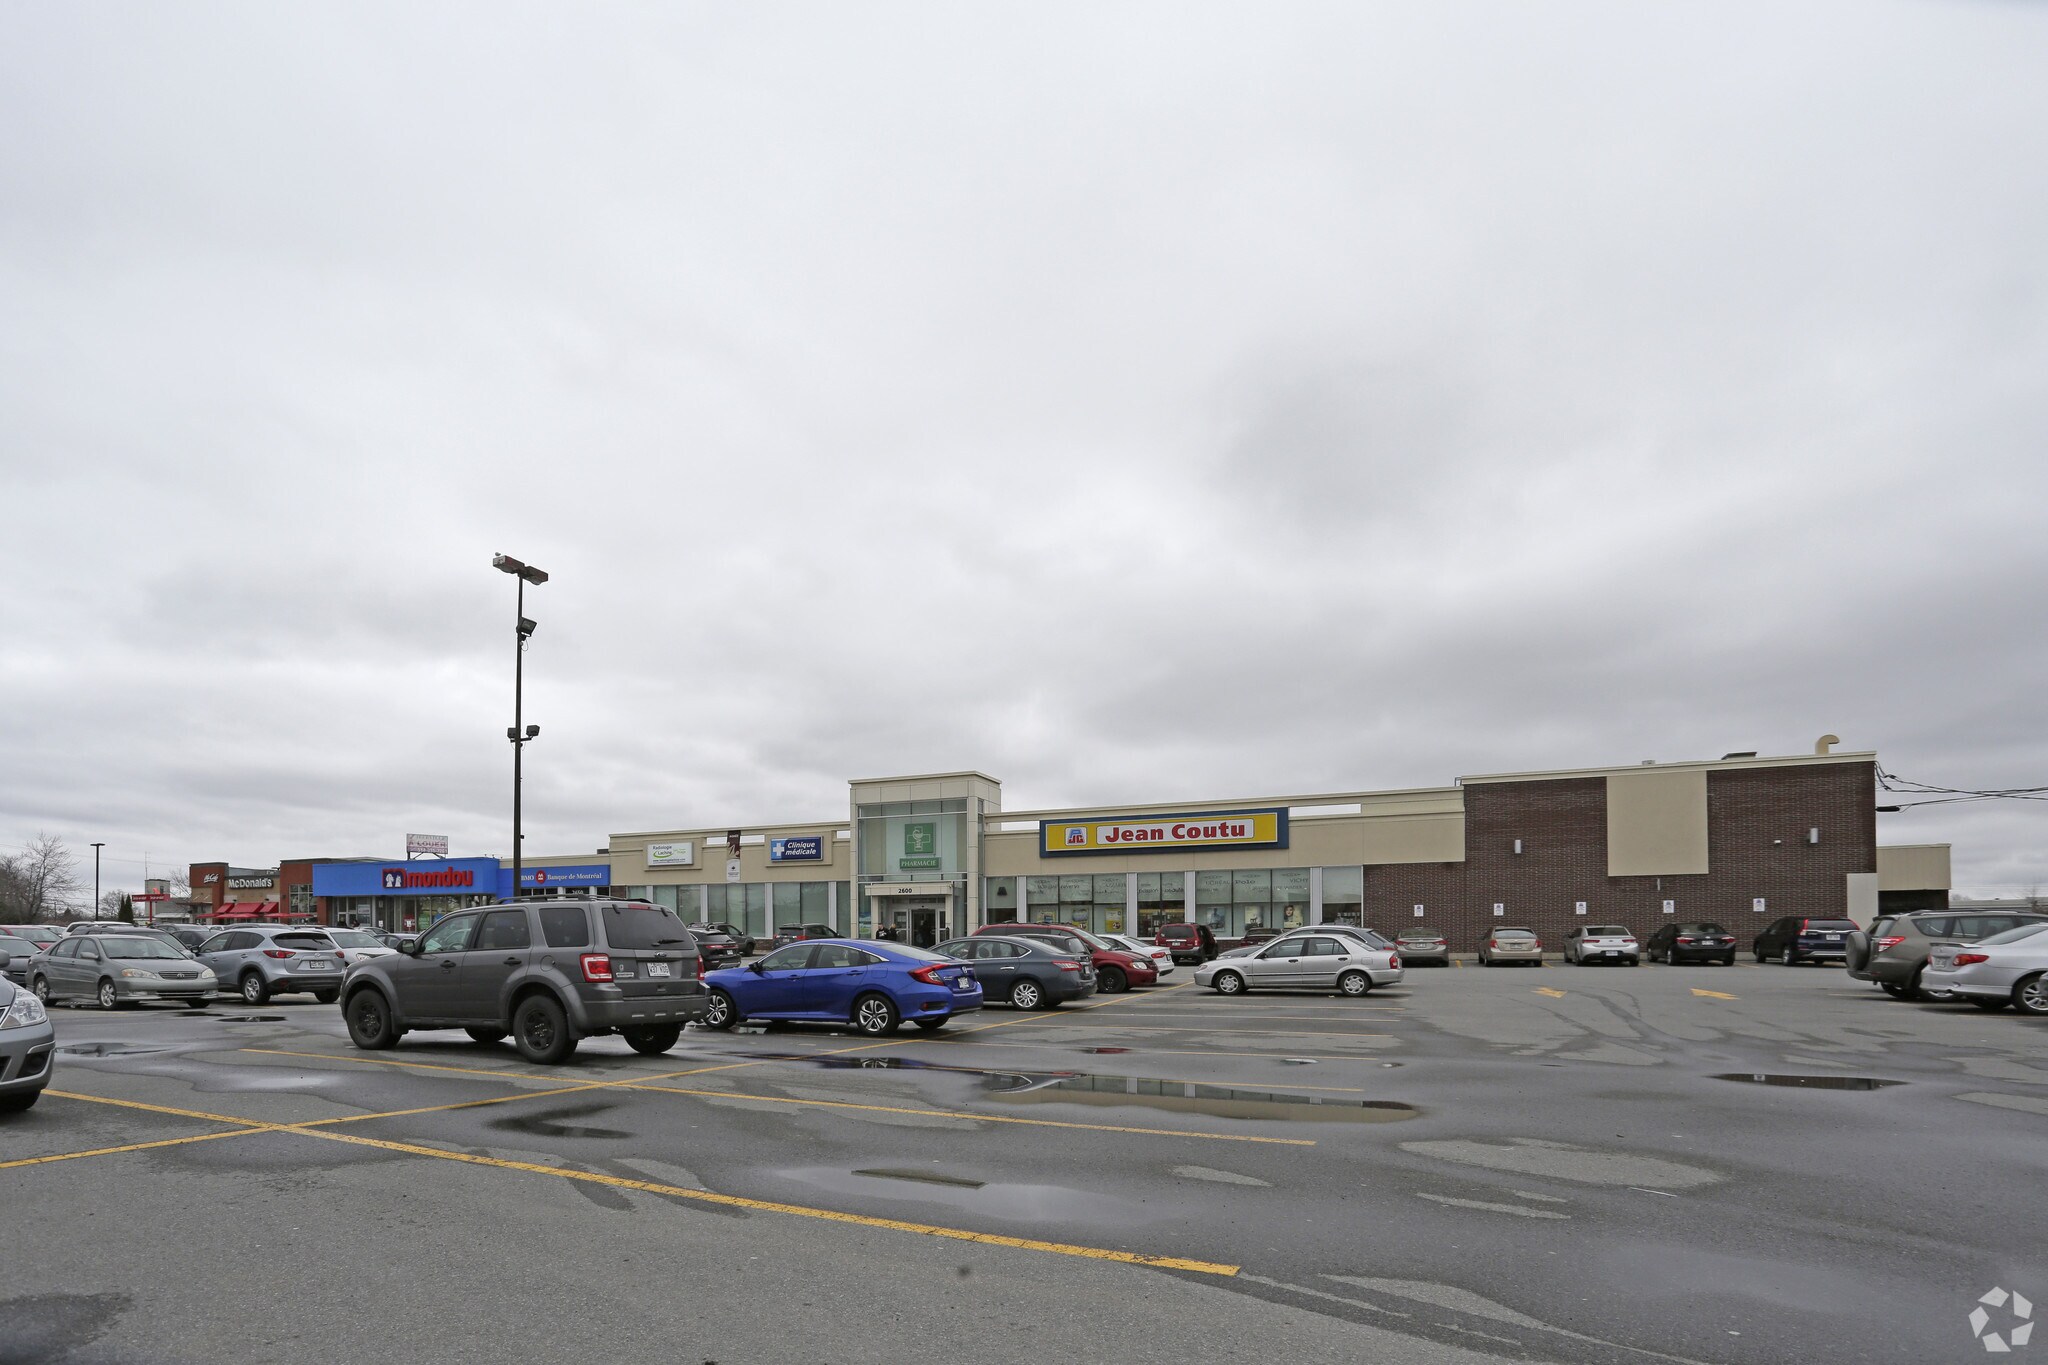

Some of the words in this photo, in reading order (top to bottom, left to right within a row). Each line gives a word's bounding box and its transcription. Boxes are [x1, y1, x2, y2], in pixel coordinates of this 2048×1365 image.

[1105, 827, 1164, 843] Jean
[1171, 822, 1245, 839] Coutu
[787, 841, 816, 850] Clinique
[785, 848, 817, 856] médicale
[407, 866, 474, 888] mondou
[547, 874, 567, 882] Banque
[576, 872, 602, 880] Montréal
[228, 878, 274, 890] McDonald's
